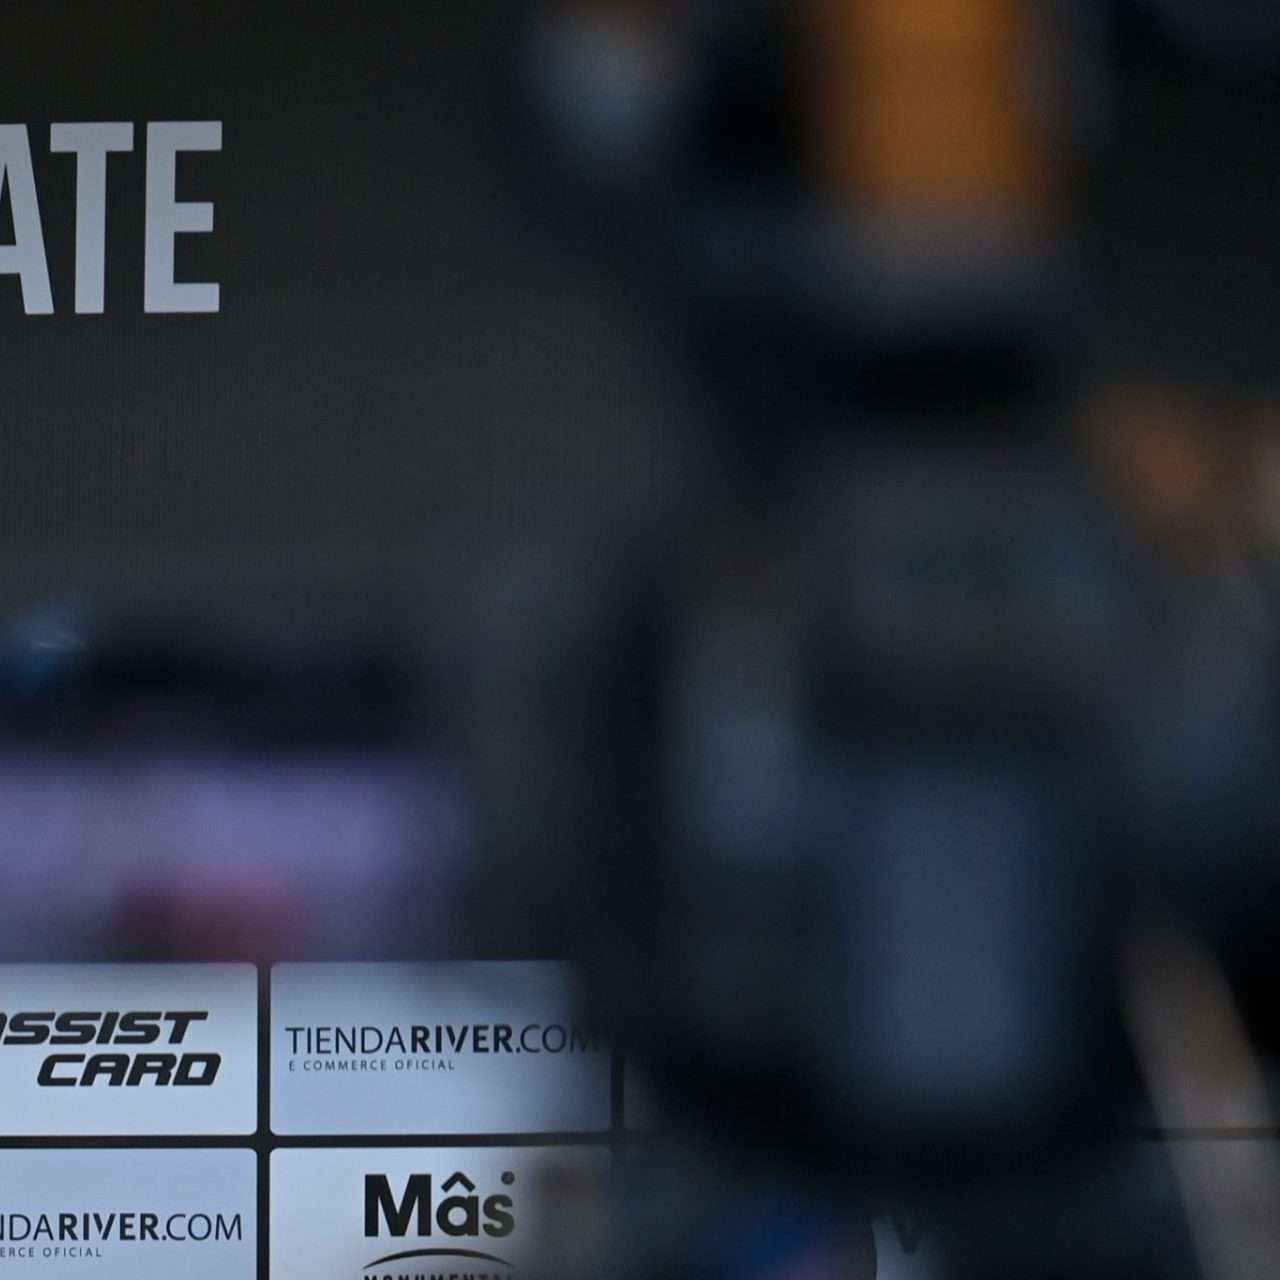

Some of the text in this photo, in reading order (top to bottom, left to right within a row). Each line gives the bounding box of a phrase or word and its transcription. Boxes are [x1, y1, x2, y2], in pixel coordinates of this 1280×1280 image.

[36, 1053, 222, 1087] CARD
[288, 1059, 455, 1071] E COMMERCE OFICIAL
[363, 1171, 515, 1238] Mâs
[42, 1246, 102, 1258] OFICIAL
